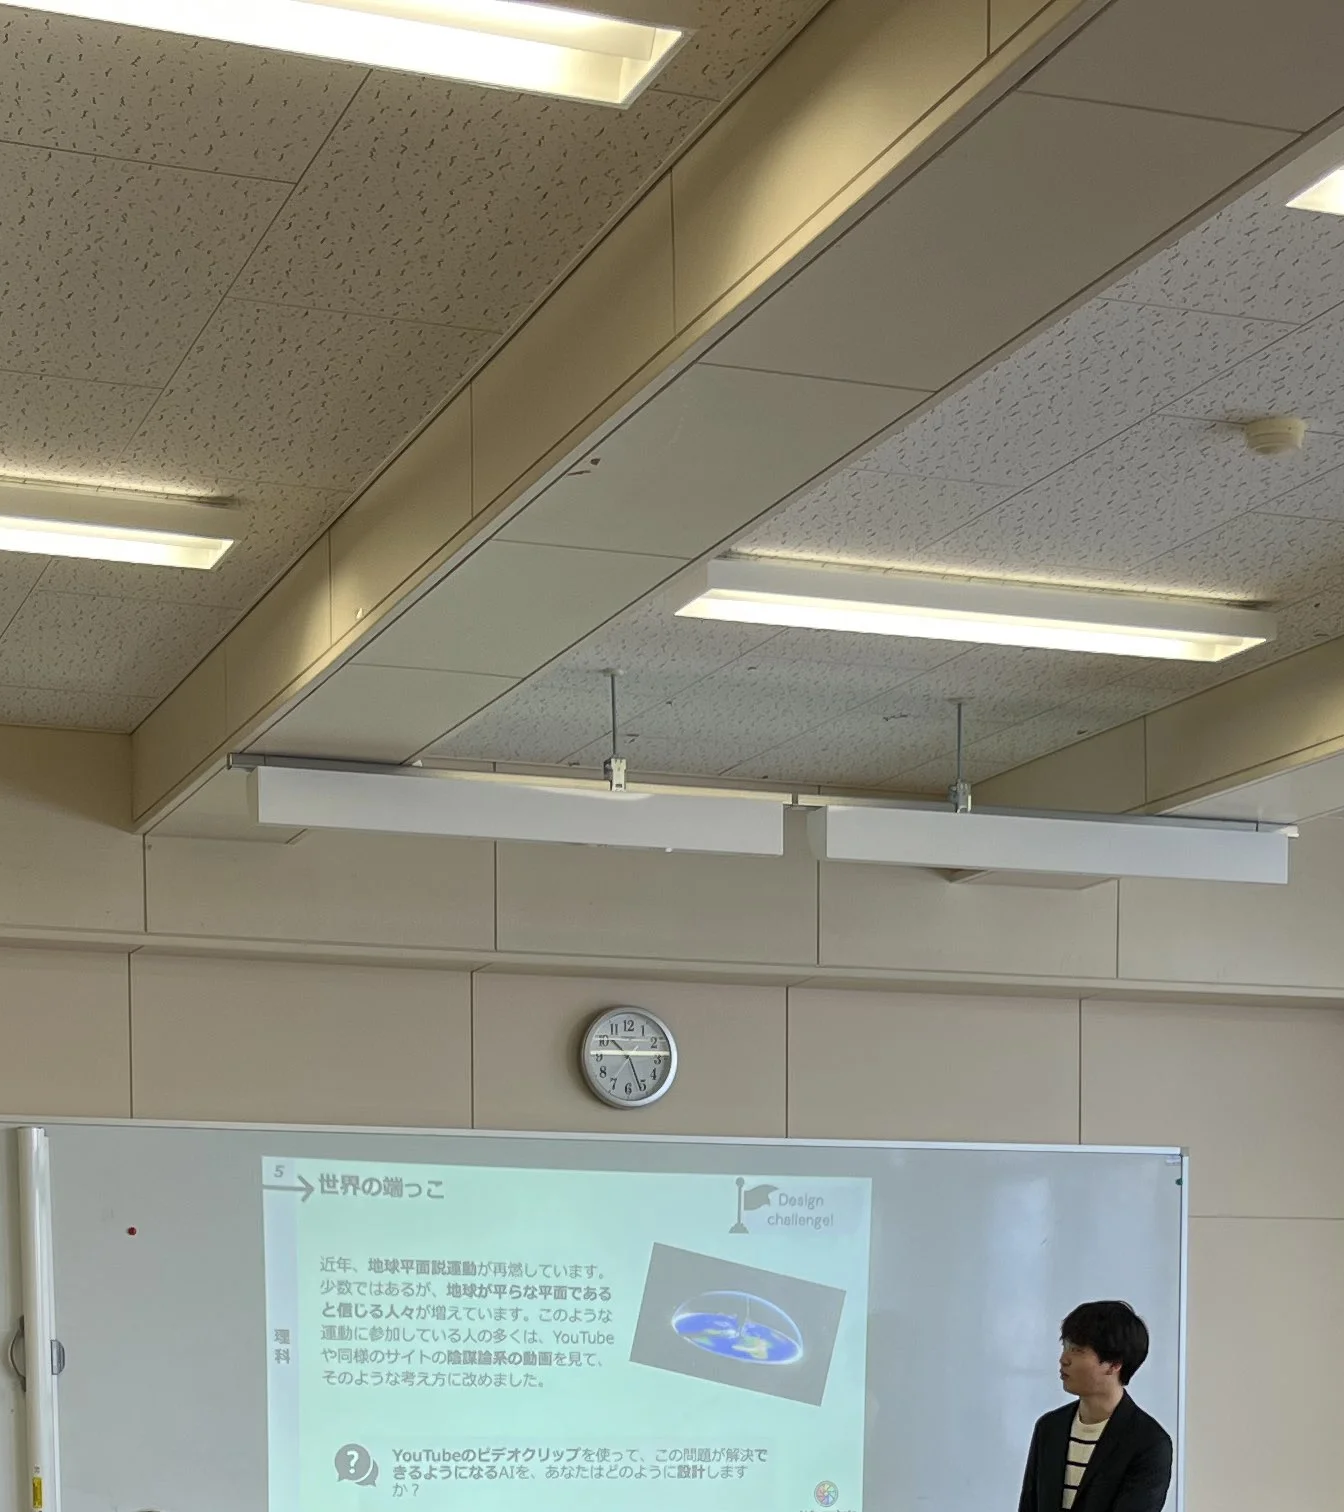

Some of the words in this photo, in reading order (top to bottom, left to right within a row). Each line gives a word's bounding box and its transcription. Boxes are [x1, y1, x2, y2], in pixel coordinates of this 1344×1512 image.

[610, 1023, 619, 1036] 11
[623, 1019, 635, 1032] 12
[650, 1036, 658, 1049] 2
[599, 1065, 607, 1078] 8
[650, 1067, 657, 1080] 4
[610, 1078, 618, 1090] 7
[624, 1082, 632, 1095] 6
[273, 1164, 286, 1179] 5
[318, 1172, 446, 1200] 世界の端っこ
[778, 1192, 825, 1210] Design
[767, 1212, 834, 1230] challenge!
[319, 1279, 612, 1302] 少数ではあるが、地球が平らな平面である
[321, 1301, 613, 1324] と信じる人々が増えています。このような
[322, 1369, 545, 1388] そのような考え方に改めました。
[391, 1447, 768, 1464] YouTubeのビデオクリップを使って、この問題が解決で
[392, 1464, 749, 1481] きるようになるAIを、あなたはどのように設計します
